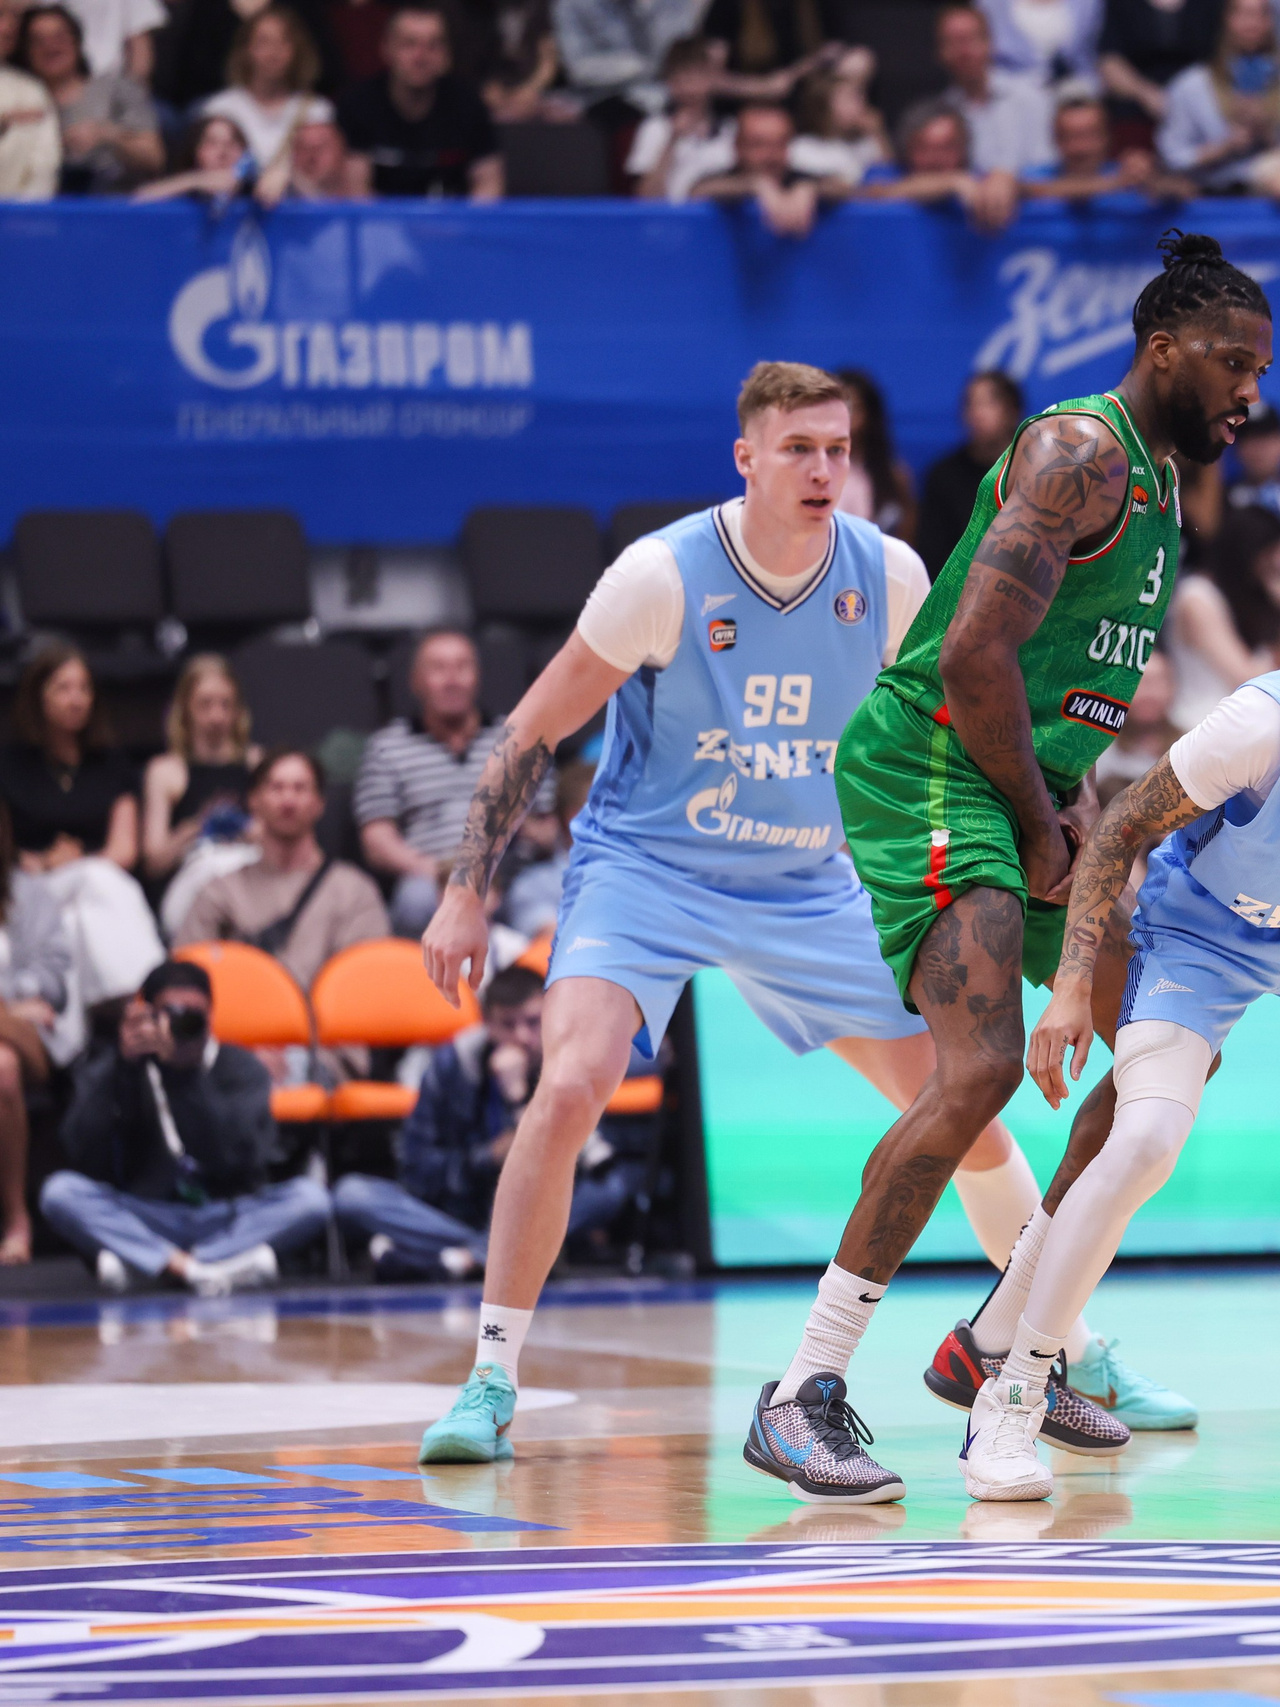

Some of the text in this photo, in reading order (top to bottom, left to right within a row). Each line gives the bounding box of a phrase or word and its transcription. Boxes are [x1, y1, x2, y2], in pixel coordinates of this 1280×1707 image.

[281, 322, 534, 388] ГАЗПРОМ
[1138, 546, 1165, 606] 3
[713, 630, 736, 641] WIN
[743, 674, 812, 728] 99
[726, 814, 832, 850] ГАЗПРОМ
